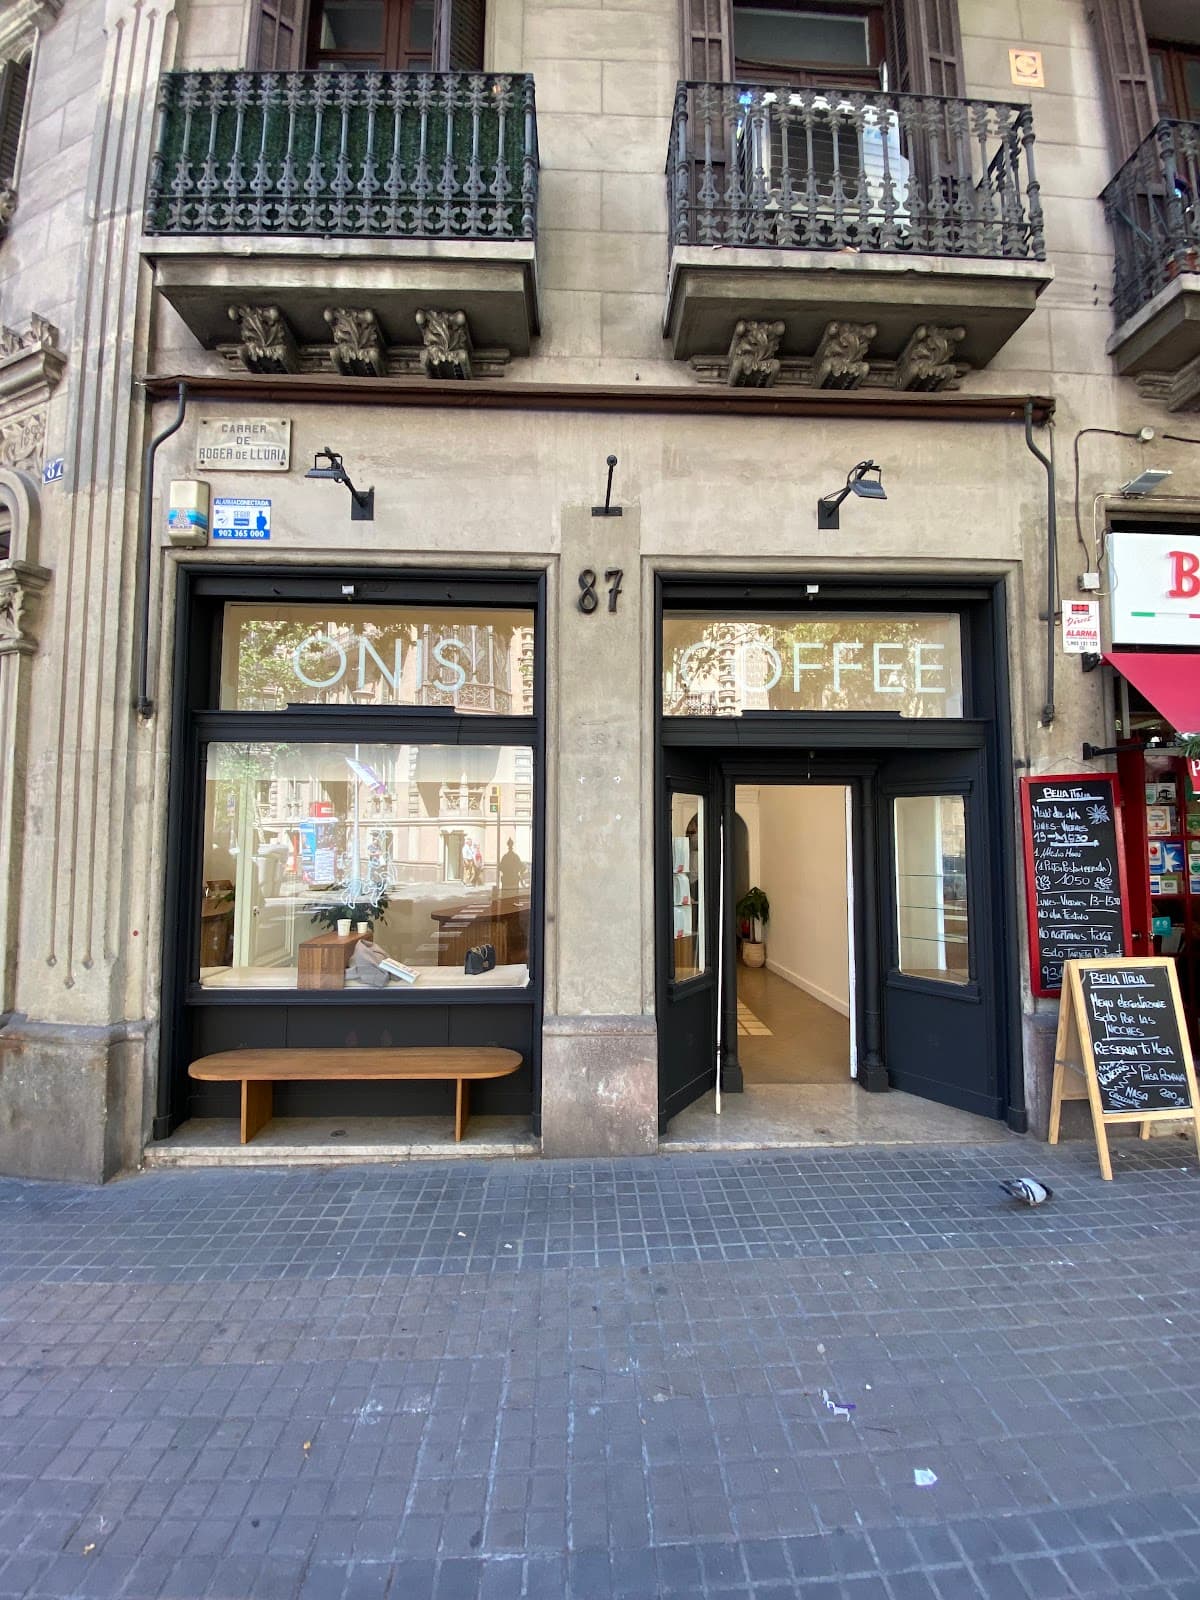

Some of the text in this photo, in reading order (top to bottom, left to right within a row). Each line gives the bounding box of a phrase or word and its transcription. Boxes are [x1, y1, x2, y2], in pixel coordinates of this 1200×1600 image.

[221, 424, 267, 433] CARRER
[236, 436, 251, 445] DE
[199, 447, 233, 460] ROGER
[250, 447, 287, 460] LLURIA
[218, 529, 264, 538] 902 365 000
[578, 569, 623, 614] 87
[1066, 629, 1098, 638] ALARMA
[293, 635, 466, 692] ONIS
[680, 640, 946, 694] COFFEE
[1089, 971, 1120, 985] BELLA
[1093, 1041, 1139, 1055] RESERVA
